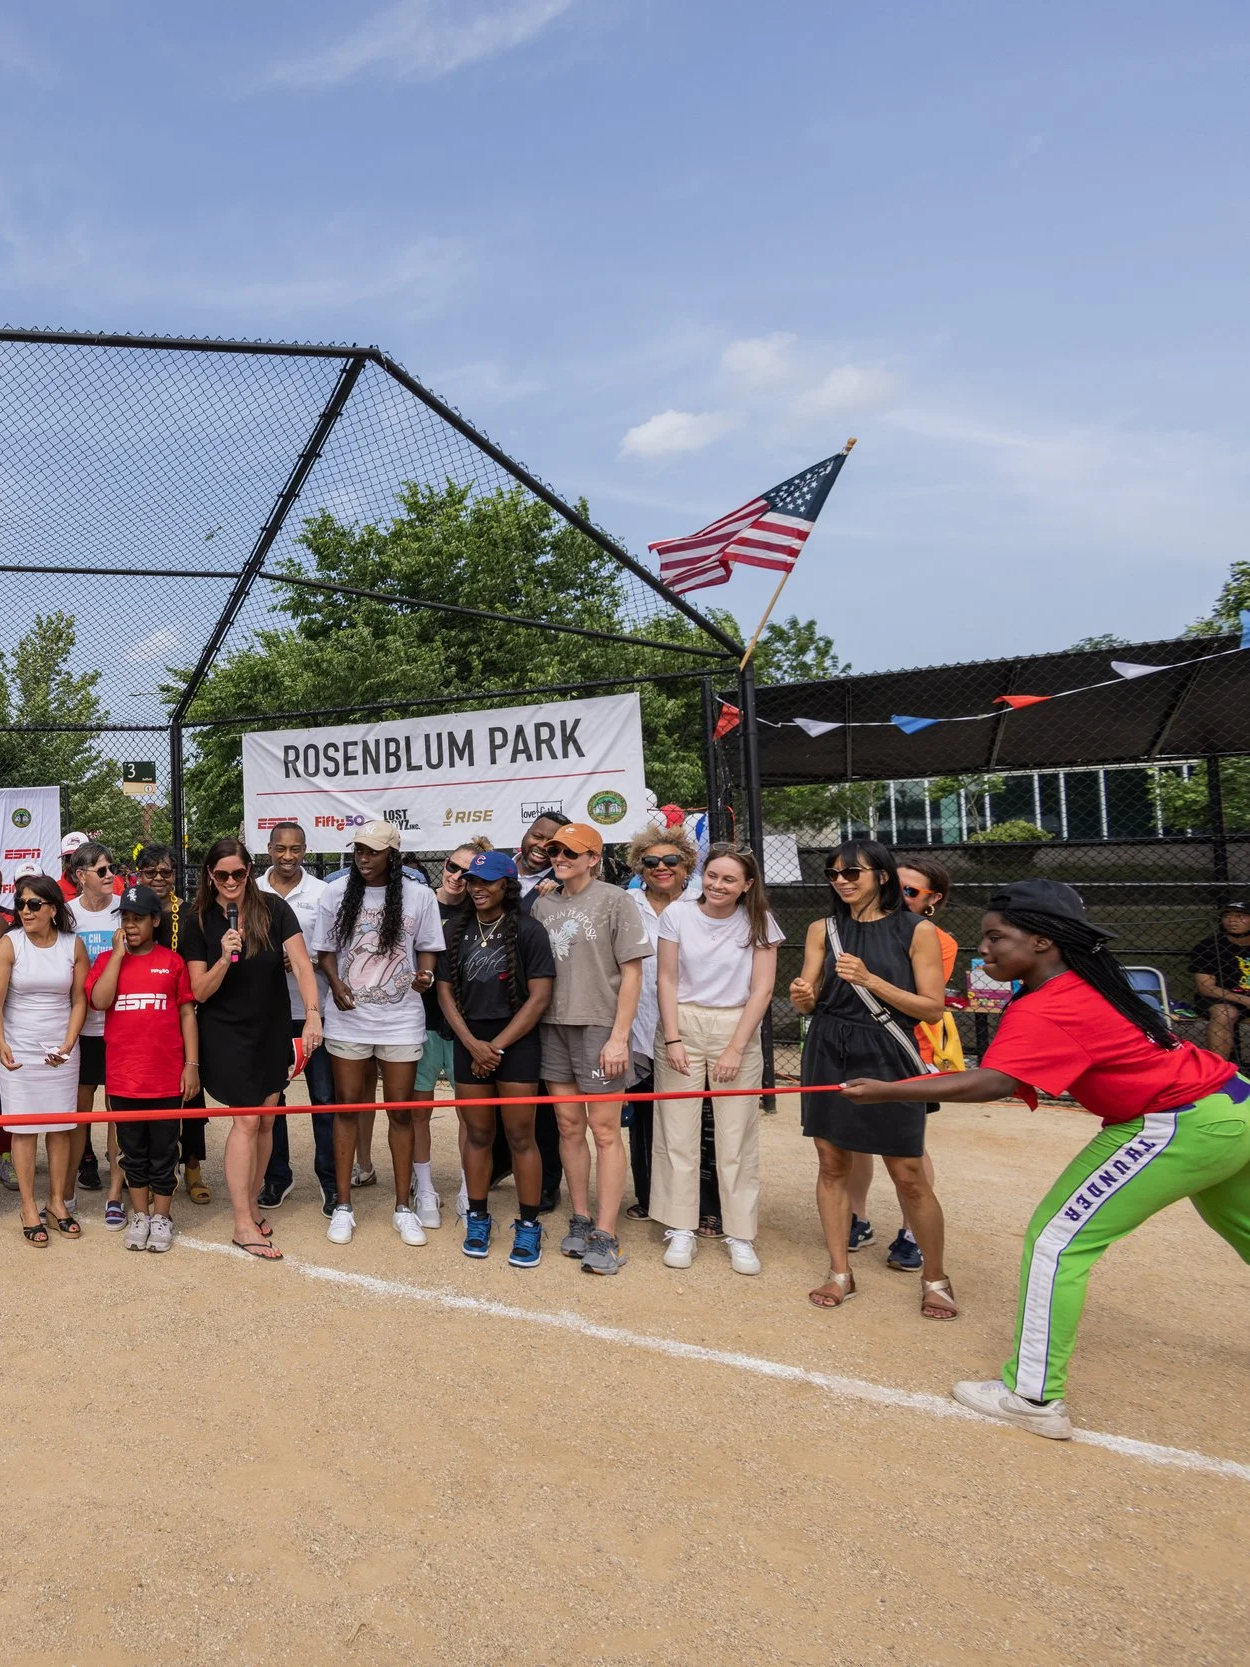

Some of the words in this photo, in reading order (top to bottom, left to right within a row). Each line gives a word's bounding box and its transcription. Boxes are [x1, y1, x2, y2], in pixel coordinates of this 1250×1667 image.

[283, 729, 474, 778] ROSENBLUM
[488, 718, 585, 765] PARK
[127, 763, 136, 778] 3
[383, 809, 408, 821] LOST
[455, 810, 493, 824] RISE
[314, 815, 366, 831] Fifty50
[4, 848, 40, 860] ESPN
[114, 993, 168, 1012] ESPN
[1064, 1138, 1156, 1222] THUNDER
